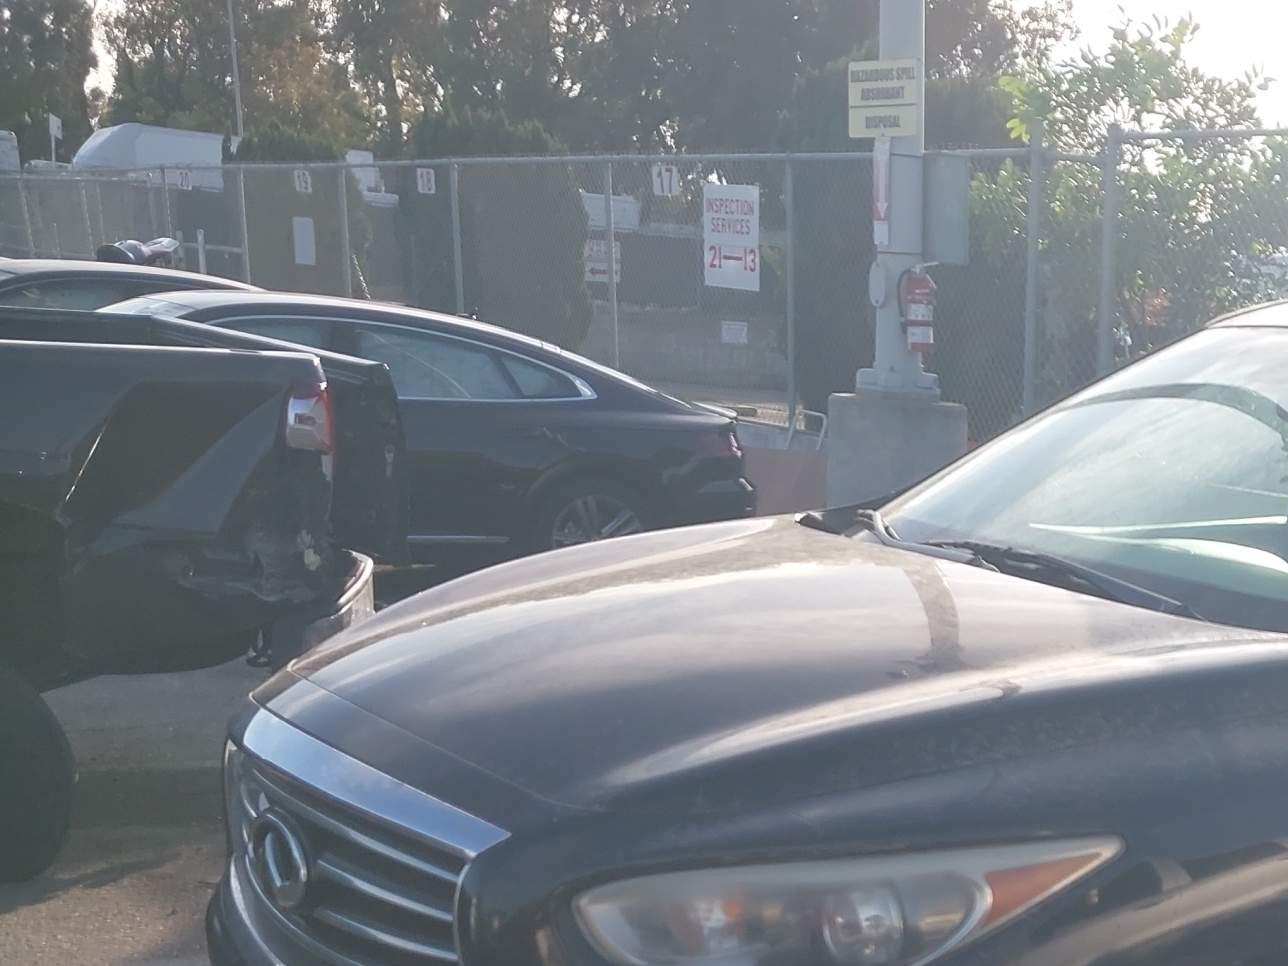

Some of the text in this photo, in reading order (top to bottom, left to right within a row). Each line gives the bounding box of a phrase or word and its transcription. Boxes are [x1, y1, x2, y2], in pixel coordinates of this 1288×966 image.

[296, 171, 309, 191] 19
[656, 167, 674, 194] 17
[705, 198, 755, 217] INSPECTION
[711, 217, 751, 235] SERVICES
